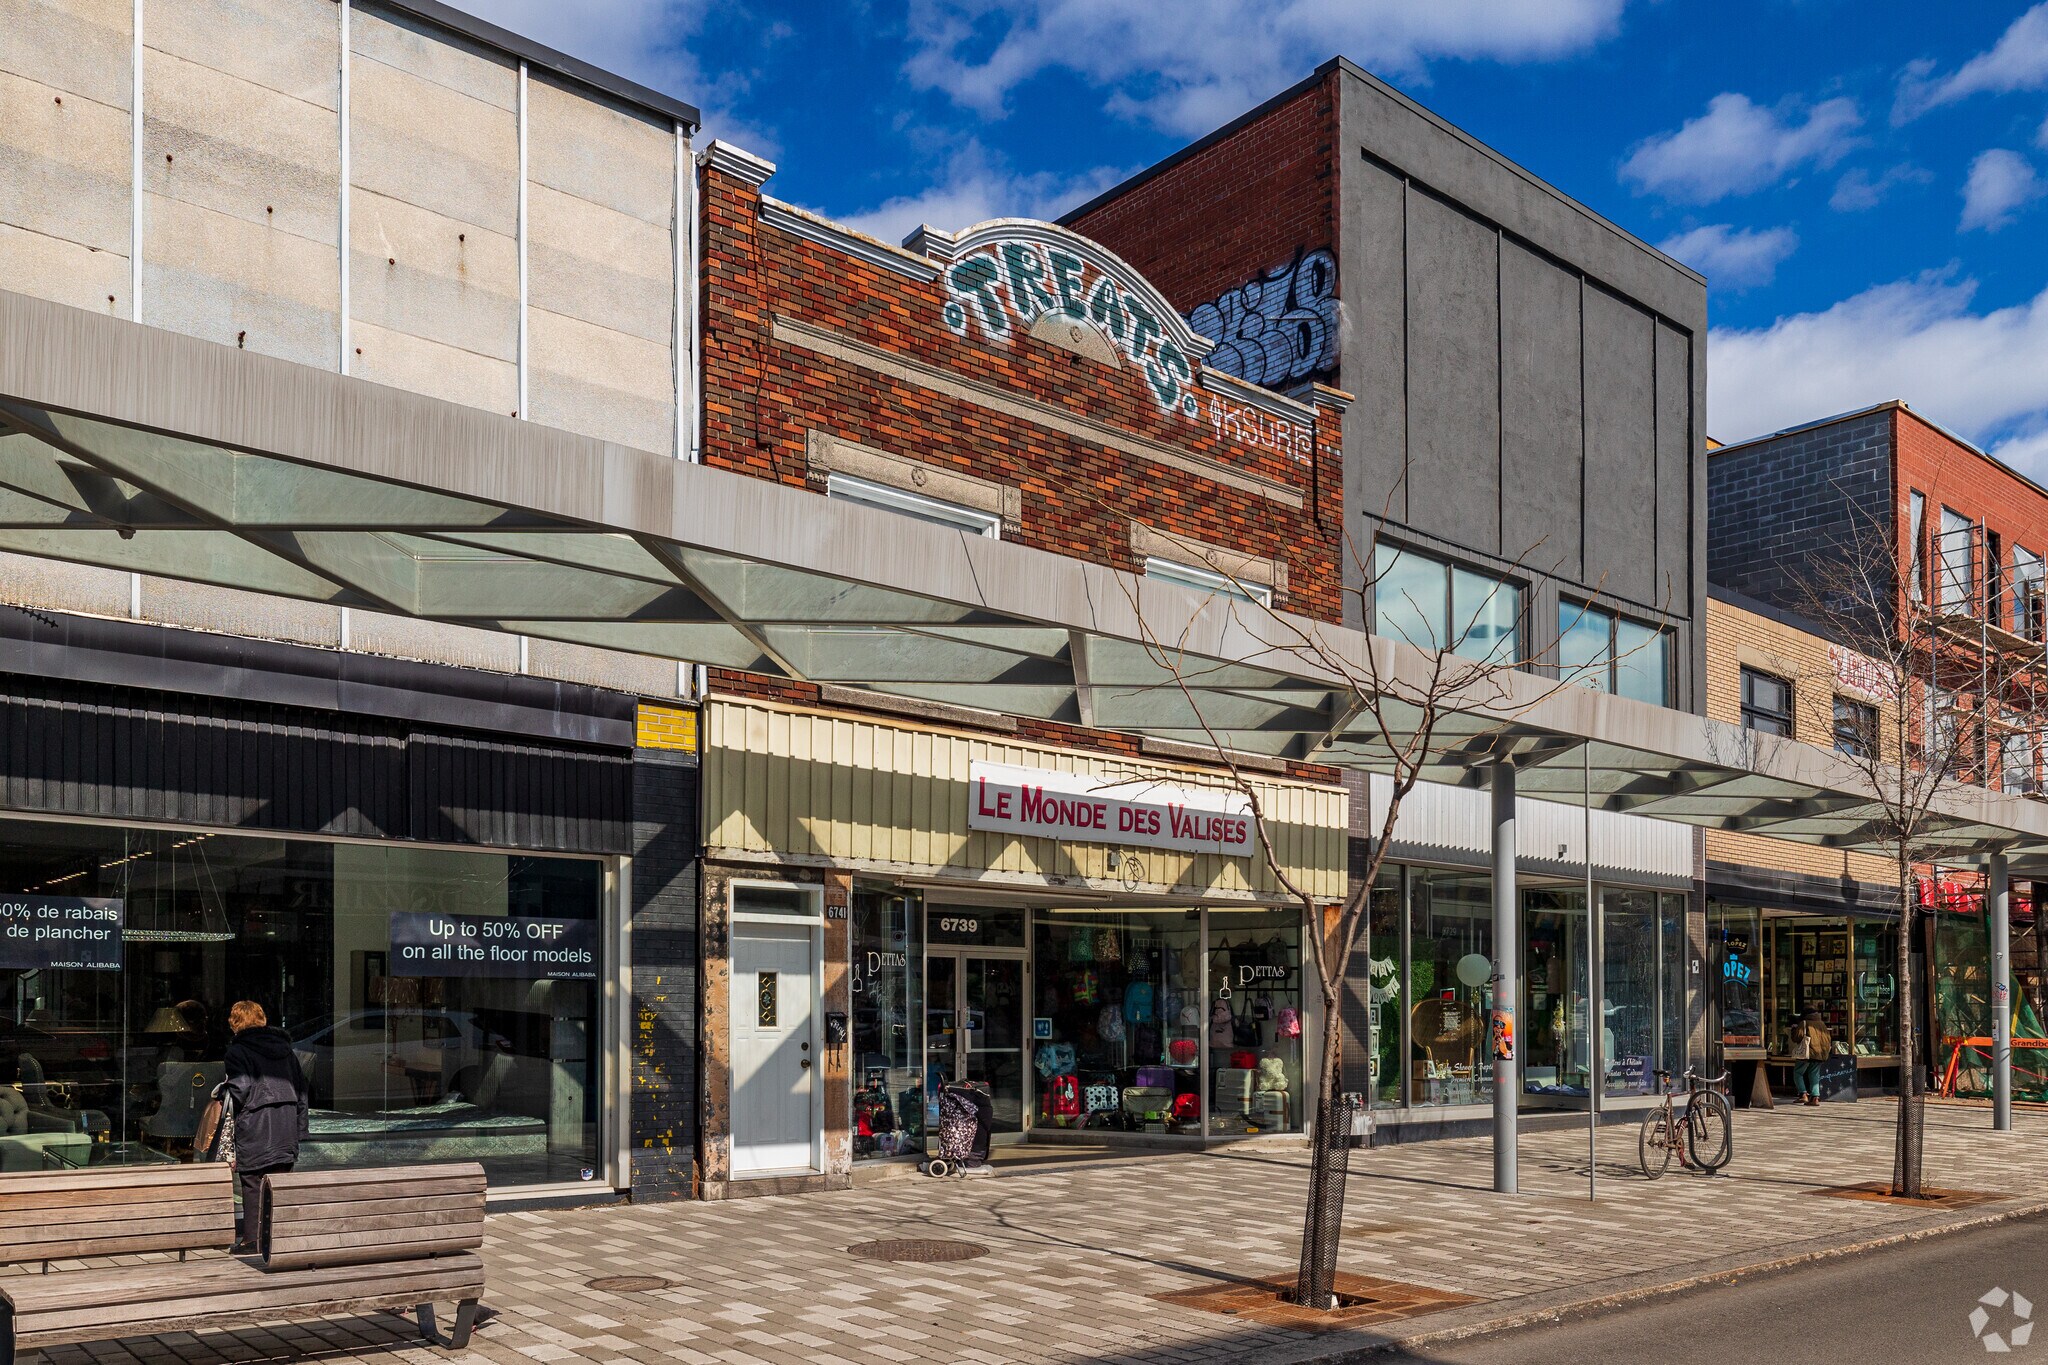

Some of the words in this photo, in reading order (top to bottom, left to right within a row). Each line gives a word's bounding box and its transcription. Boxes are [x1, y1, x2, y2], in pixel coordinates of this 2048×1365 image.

[978, 776, 1012, 820] LE
[1020, 783, 1107, 830] MONDE
[1167, 802, 1247, 845] VALISES
[0, 903, 31, 918] 0%
[36, 904, 60, 919] de
[65, 906, 119, 921] rabais
[828, 906, 847, 919] 6741
[6, 924, 30, 938] de
[35, 925, 112, 941] plancher
[429, 919, 455, 940] Up
[460, 922, 478, 938] to
[482, 922, 521, 939] 50%
[526, 923, 564, 940] OFF
[940, 918, 978, 933] 6739
[402, 945, 426, 960] on
[431, 944, 452, 960] all
[457, 945, 485, 961] the
[490, 946, 529, 962] floor
[532, 948, 592, 964] models
